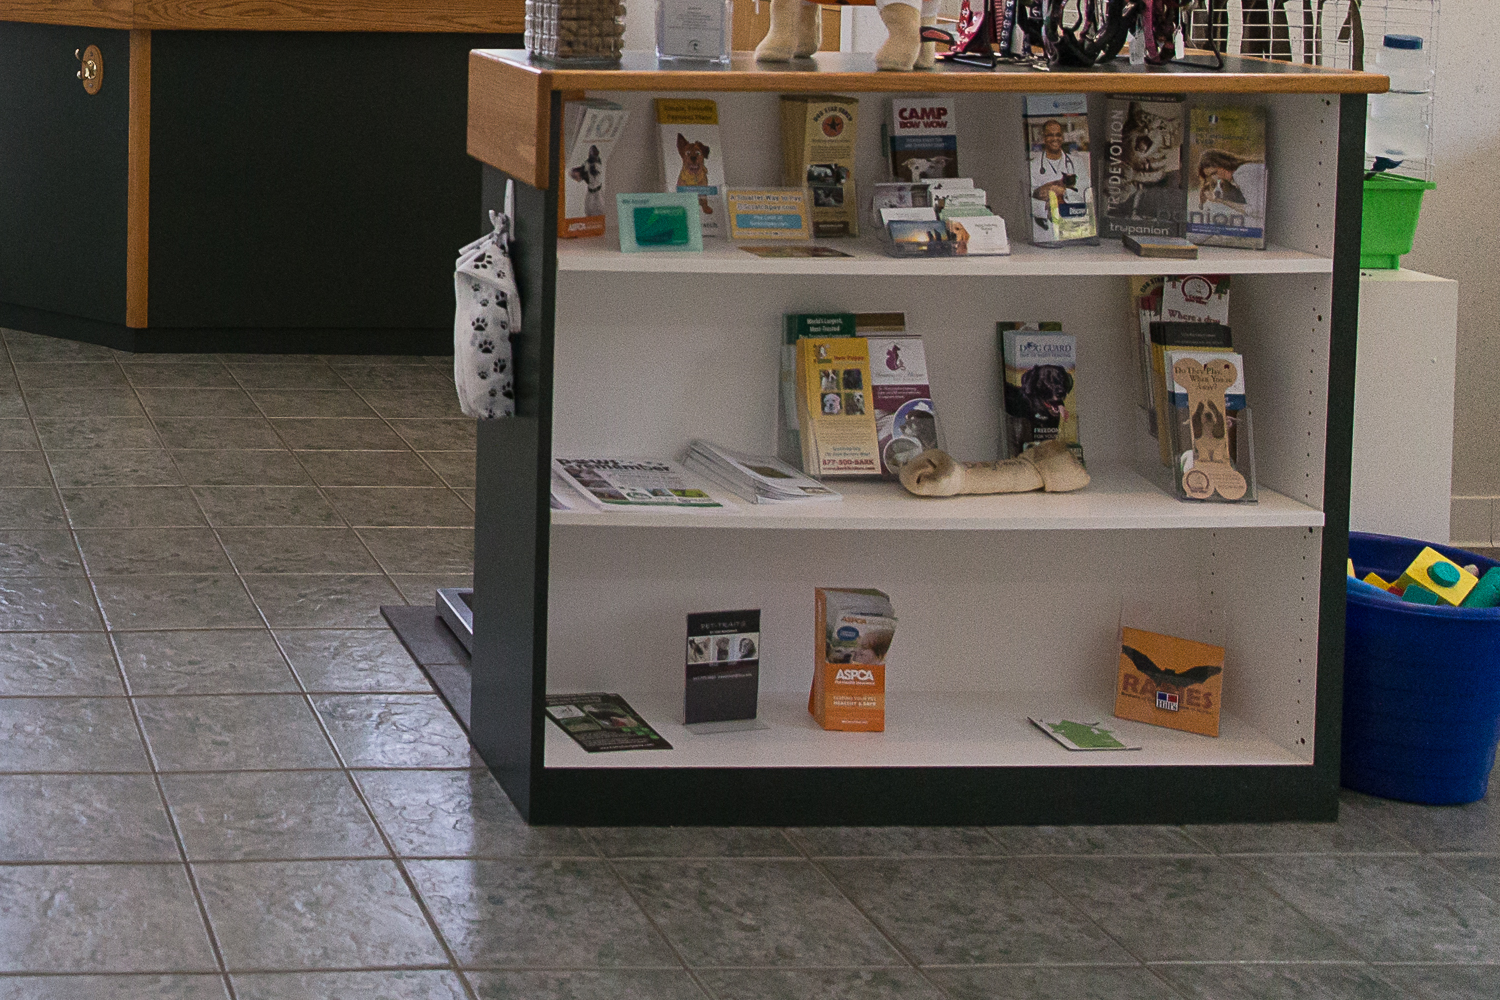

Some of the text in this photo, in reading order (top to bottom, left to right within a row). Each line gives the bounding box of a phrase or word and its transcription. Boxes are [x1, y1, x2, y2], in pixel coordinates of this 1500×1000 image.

[898, 106, 948, 121] CAMP
[898, 120, 948, 129] BOW WOW
[1106, 109, 1124, 213] TRUDEVOTION
[1109, 222, 1169, 236] trupanion
[1167, 309, 1196, 321] Where
[1043, 344, 1072, 352] GUARD
[1174, 366, 1186, 374] Do
[835, 668, 874, 681] ASPCA
